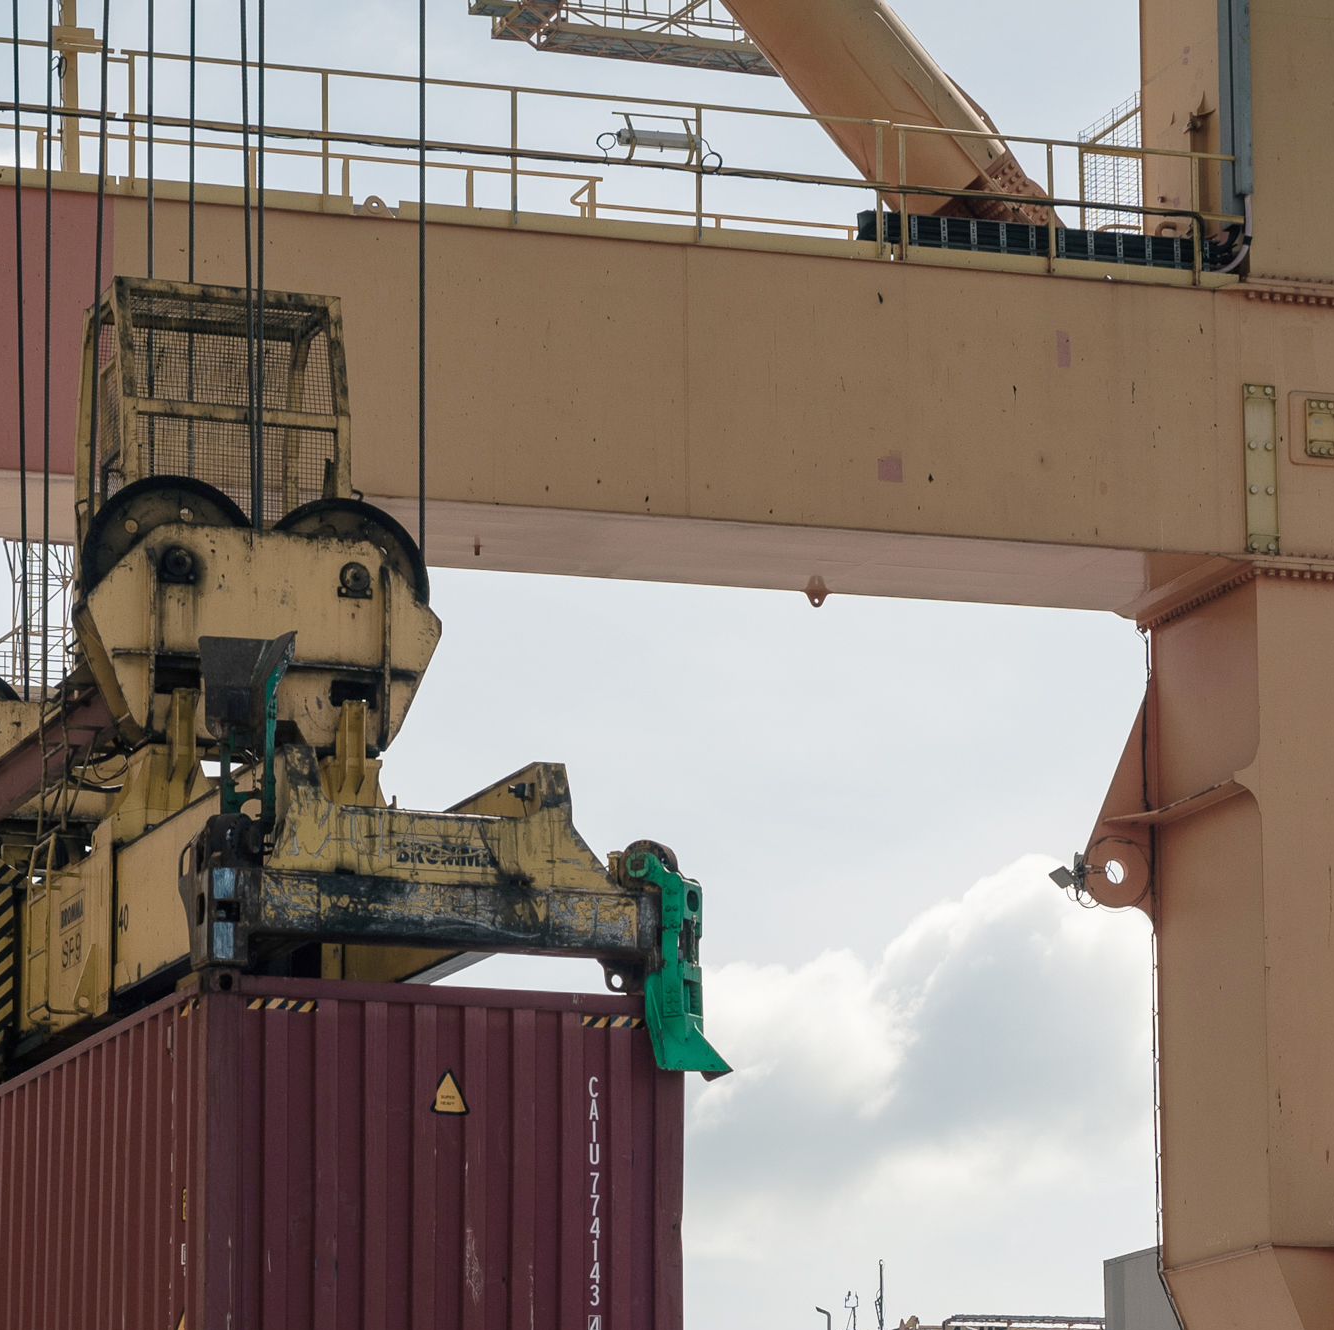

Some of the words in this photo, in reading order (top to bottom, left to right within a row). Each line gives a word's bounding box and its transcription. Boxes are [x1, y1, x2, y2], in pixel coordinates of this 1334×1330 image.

[60, 898, 84, 929] BROMMA
[118, 904, 128, 935] 40
[61, 932, 82, 969] SF9
[588, 1076, 600, 1165] CAIU
[590, 1172, 600, 1306] 774143
